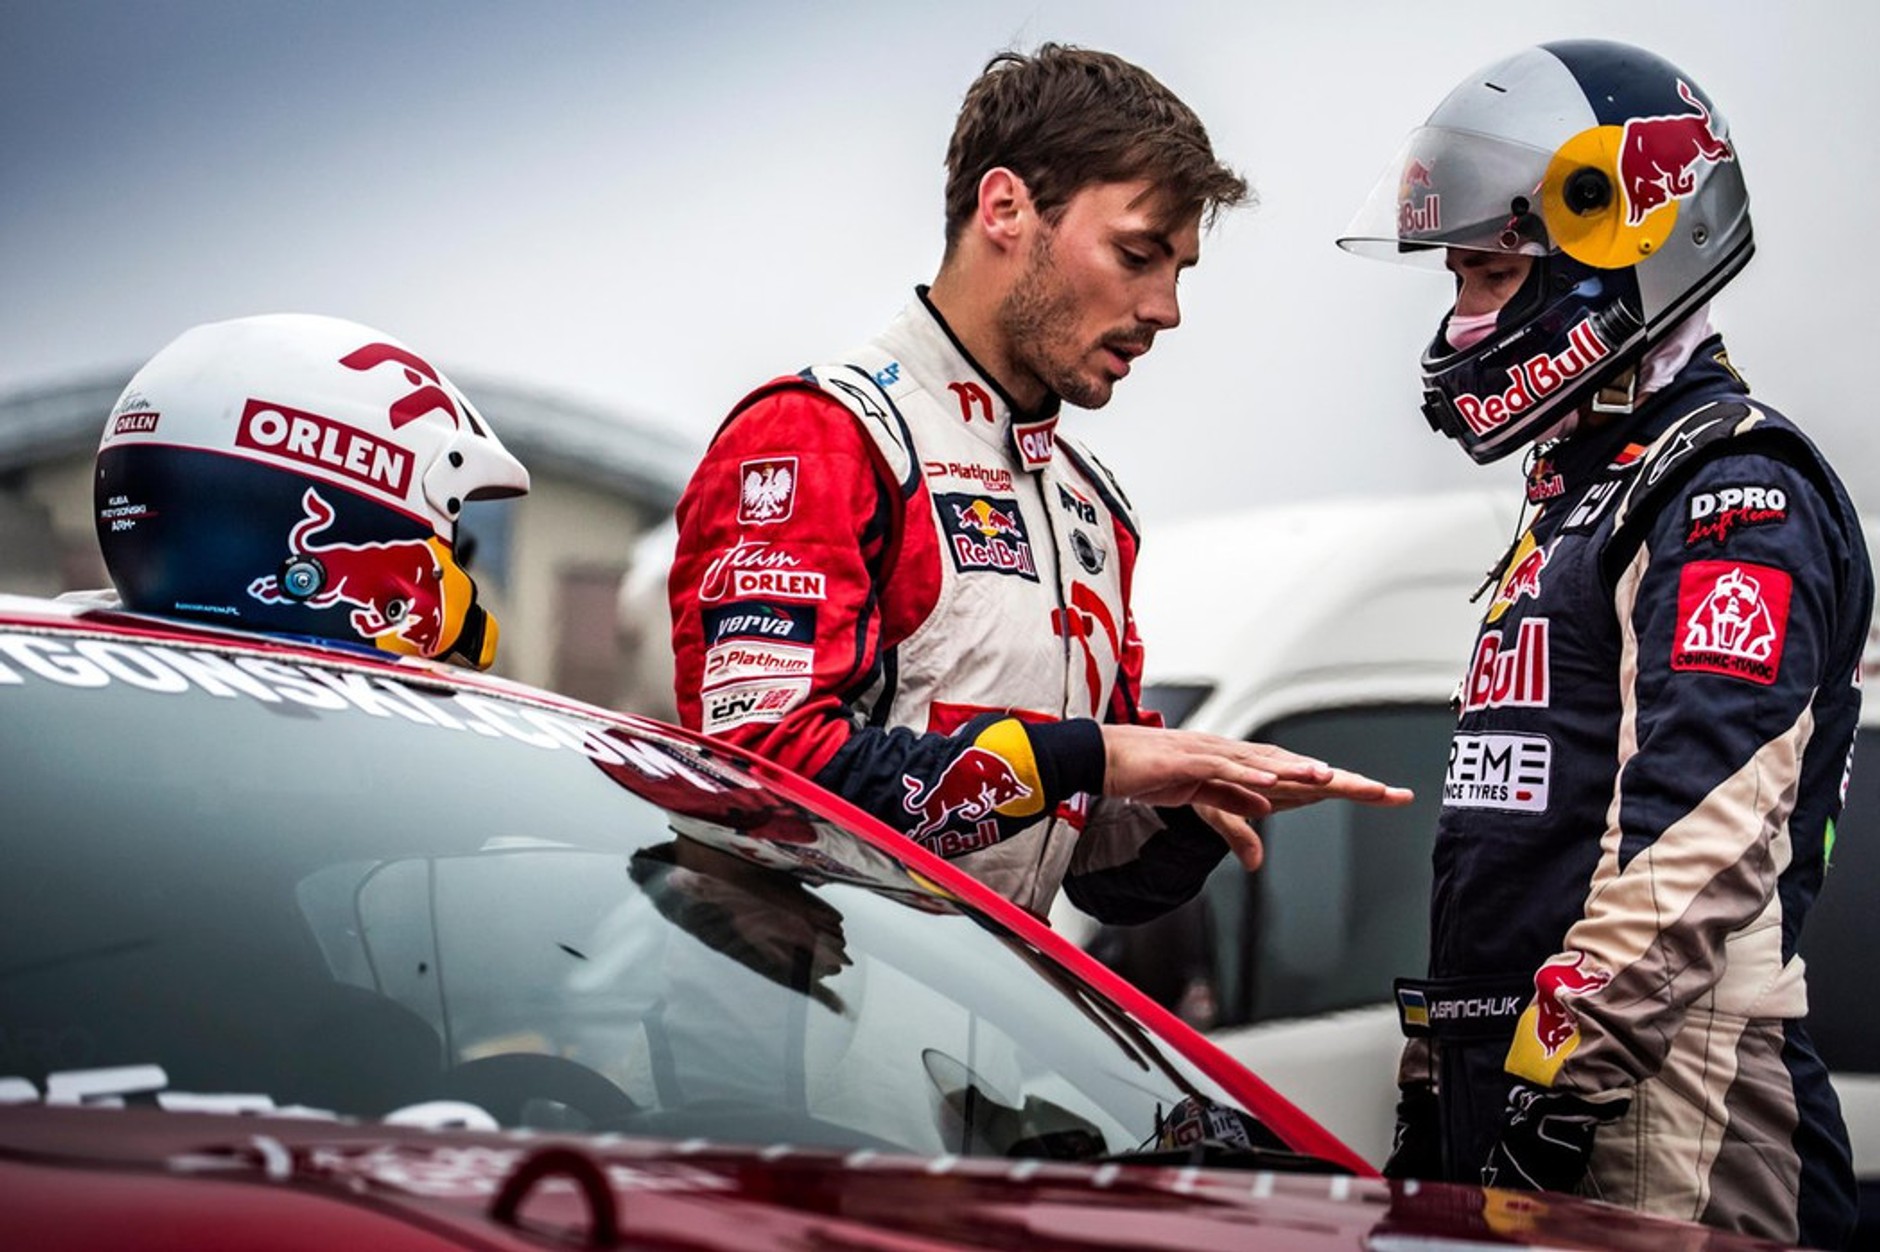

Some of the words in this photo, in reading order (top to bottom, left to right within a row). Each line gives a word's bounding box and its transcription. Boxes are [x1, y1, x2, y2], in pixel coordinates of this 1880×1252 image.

[1454, 364, 1536, 436] Red
[1523, 318, 1610, 398] Bull
[117, 416, 156, 432] ORLEN
[250, 409, 405, 489] ORLEN
[948, 462, 1012, 484] Platinum
[952, 534, 1000, 567] Red
[993, 538, 1037, 577] Bull
[740, 573, 820, 595] ORLEN
[717, 614, 795, 637] verva
[725, 650, 809, 670] Platinum
[1466, 617, 1550, 712] Bull
[1469, 784, 1510, 802] TYRES
[938, 818, 1000, 857] Bull
